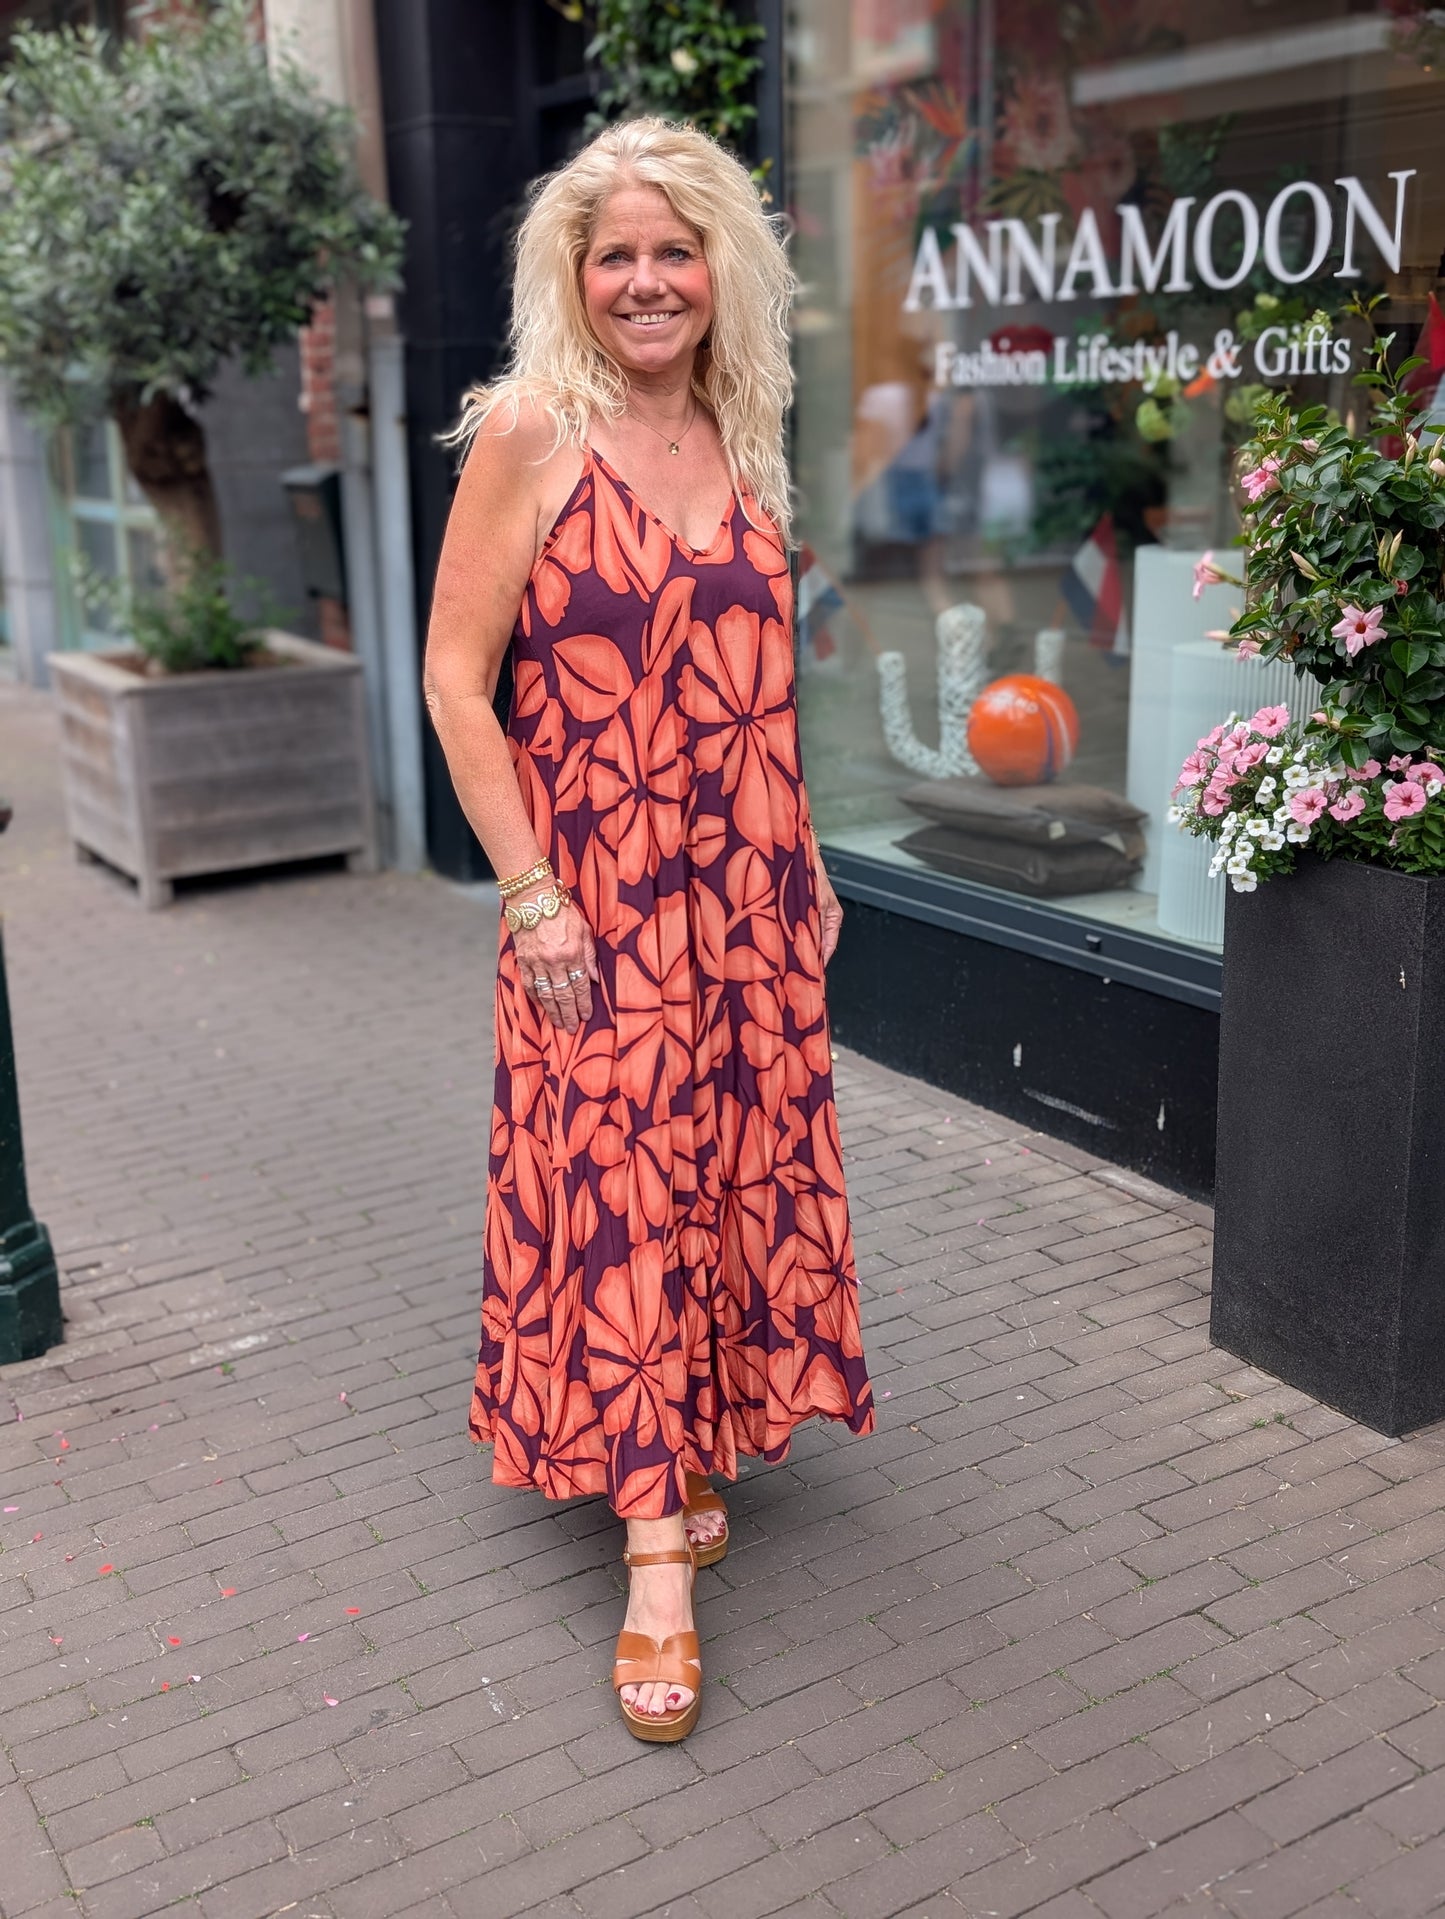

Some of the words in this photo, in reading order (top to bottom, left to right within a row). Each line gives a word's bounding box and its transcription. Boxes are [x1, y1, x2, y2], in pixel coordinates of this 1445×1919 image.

[904, 169, 1417, 312] ANNAMOON
[934, 338, 1046, 387] Fashion
[1053, 328, 1199, 392] Lifestyle
[1206, 328, 1243, 379] &
[1253, 324, 1352, 377] Gifts
